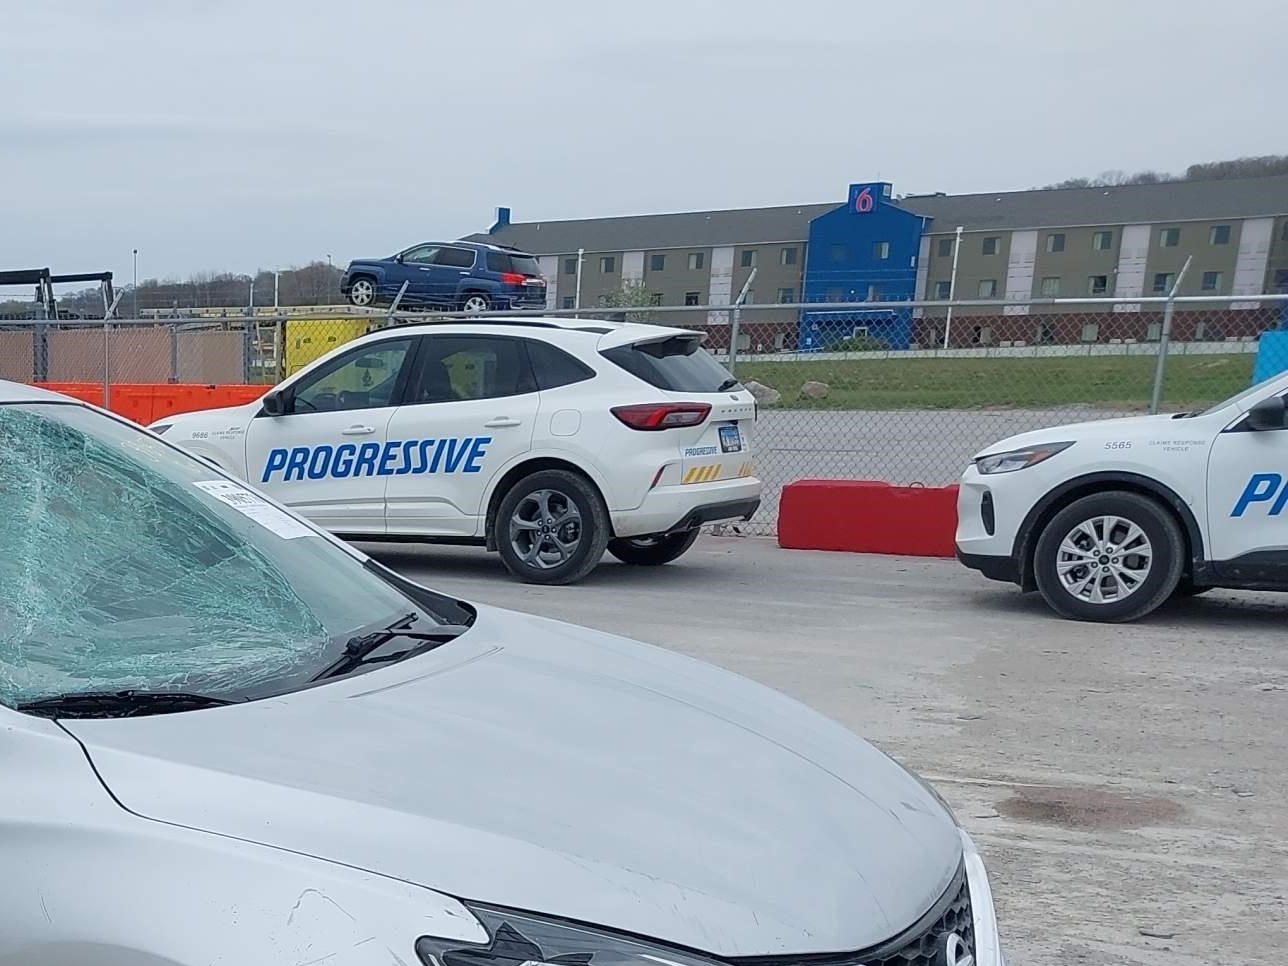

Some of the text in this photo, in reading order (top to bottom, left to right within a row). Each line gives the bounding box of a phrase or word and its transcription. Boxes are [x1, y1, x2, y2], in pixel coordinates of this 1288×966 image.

[855, 187, 873, 213] 6
[1103, 440, 1132, 450] 5565
[261, 437, 492, 483] PROGRESSIVE
